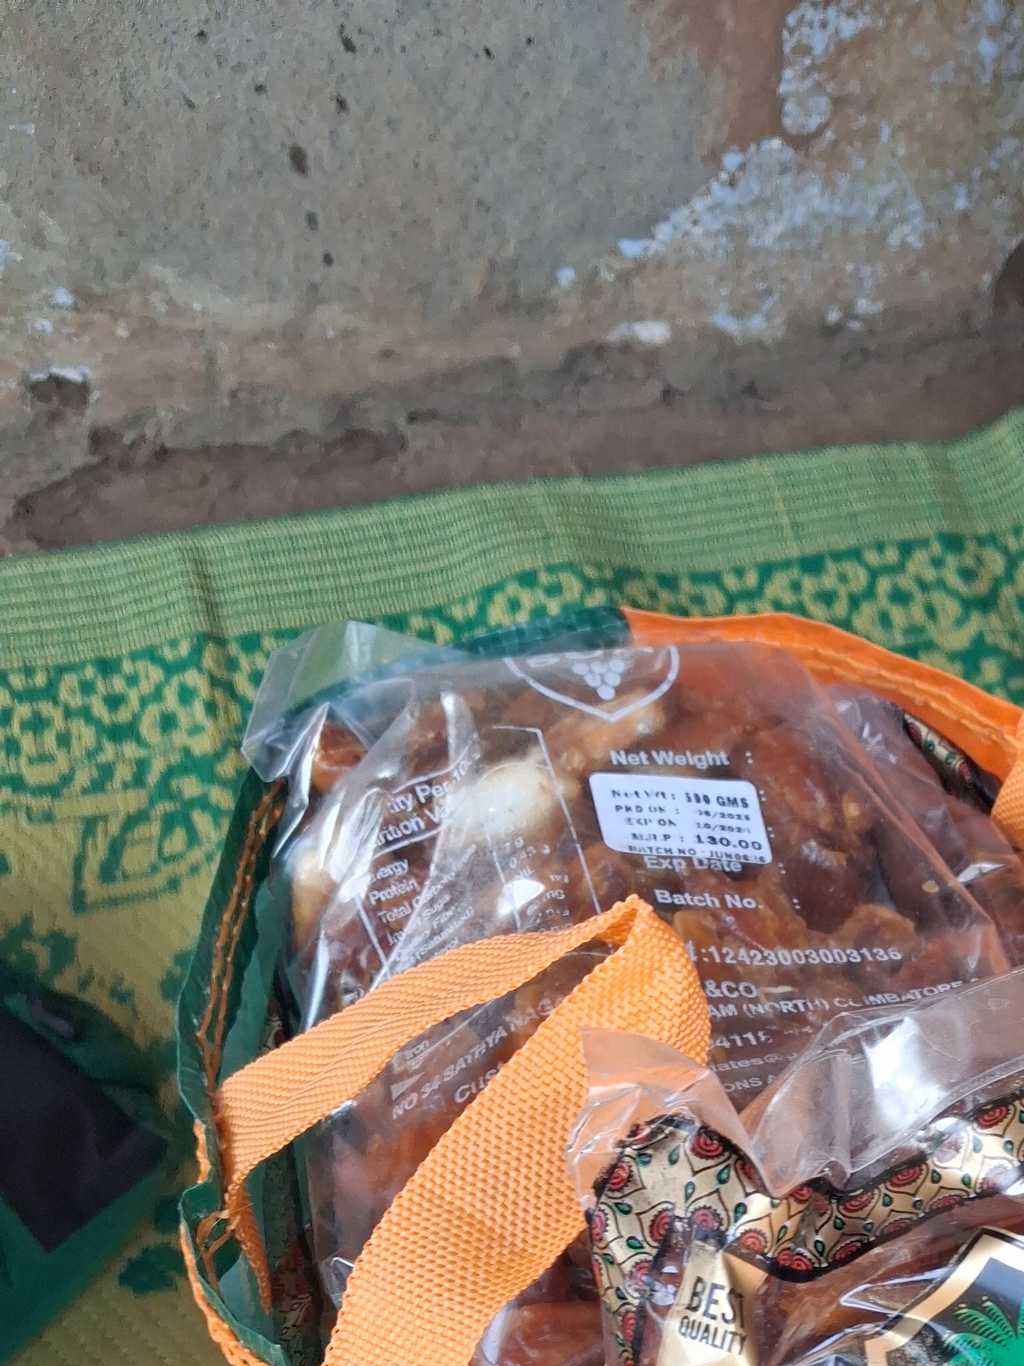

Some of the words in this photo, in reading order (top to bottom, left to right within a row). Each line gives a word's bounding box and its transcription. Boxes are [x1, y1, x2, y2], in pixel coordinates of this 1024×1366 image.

[610, 750, 648, 767] Net
[650, 750, 730, 769] Weight
[716, 796, 750, 809] GMS
[696, 834, 763, 851] 130.00
[644, 856, 689, 873] Exp
[368, 878, 419, 905] Protein
[654, 888, 718, 907] Batch
[725, 893, 764, 909] No.
[377, 902, 412, 924] Total
[685, 1275, 745, 1329] BEST
[678, 1315, 748, 1356] QUALITY
